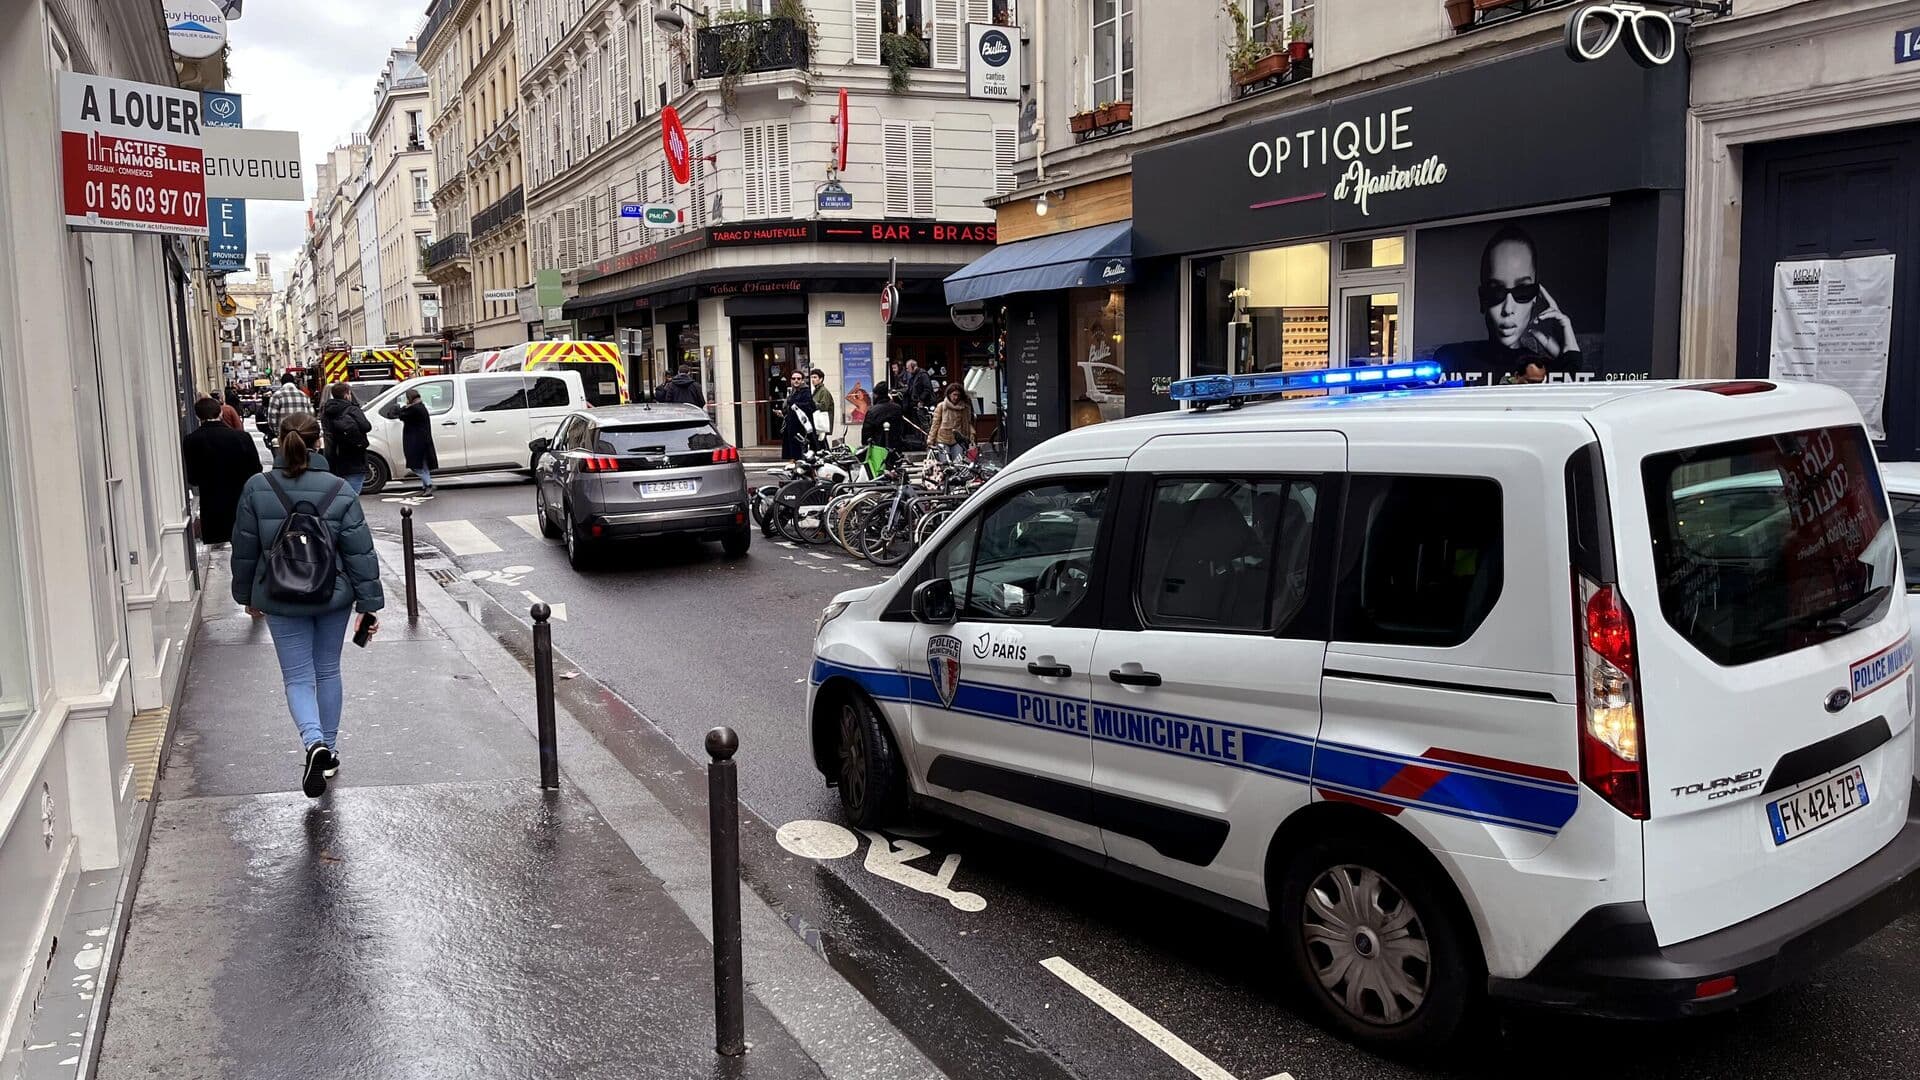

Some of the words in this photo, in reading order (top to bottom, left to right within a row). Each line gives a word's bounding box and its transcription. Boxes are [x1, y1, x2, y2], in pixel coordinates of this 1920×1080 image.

[184, 12, 222, 23] Hoquet
[984, 86, 1008, 95] CHOUX
[81, 85, 100, 122] A
[110, 88, 200, 136] LOUER
[114, 140, 166, 157] ACTIFS
[1249, 106, 1412, 178] OPTIQUE
[88, 164, 114, 174] BUREAUX
[118, 168, 153, 178] COMMERCES
[115, 152, 200, 174] IMMOBILIER
[204, 158, 300, 178] envenue
[1334, 155, 1448, 216] d'Hauteville
[86, 181, 104, 208] 01
[112, 184, 131, 211] 56
[136, 186, 156, 213] 03
[160, 188, 178, 214] 97
[183, 192, 201, 217] 07
[713, 232, 742, 240] TABAC
[754, 228, 807, 239] HAUTEVILLE
[872, 225, 910, 240] BAR
[934, 225, 996, 240] BRASS
[710, 284, 737, 294] Tabac
[742, 280, 800, 293] d'Hauteville
[1606, 372, 1648, 382] OPTIQUE
[930, 639, 960, 652] POLICE
[930, 648, 958, 658] MUNICIPALE
[993, 644, 1026, 660] PARIS
[1854, 658, 1886, 692] POLICE
[1020, 695, 1088, 731] POLICE
[1094, 708, 1238, 760] MUNICIPALE
[1670, 768, 1762, 796] TOURNEO
[1708, 780, 1764, 800] CONNECT
